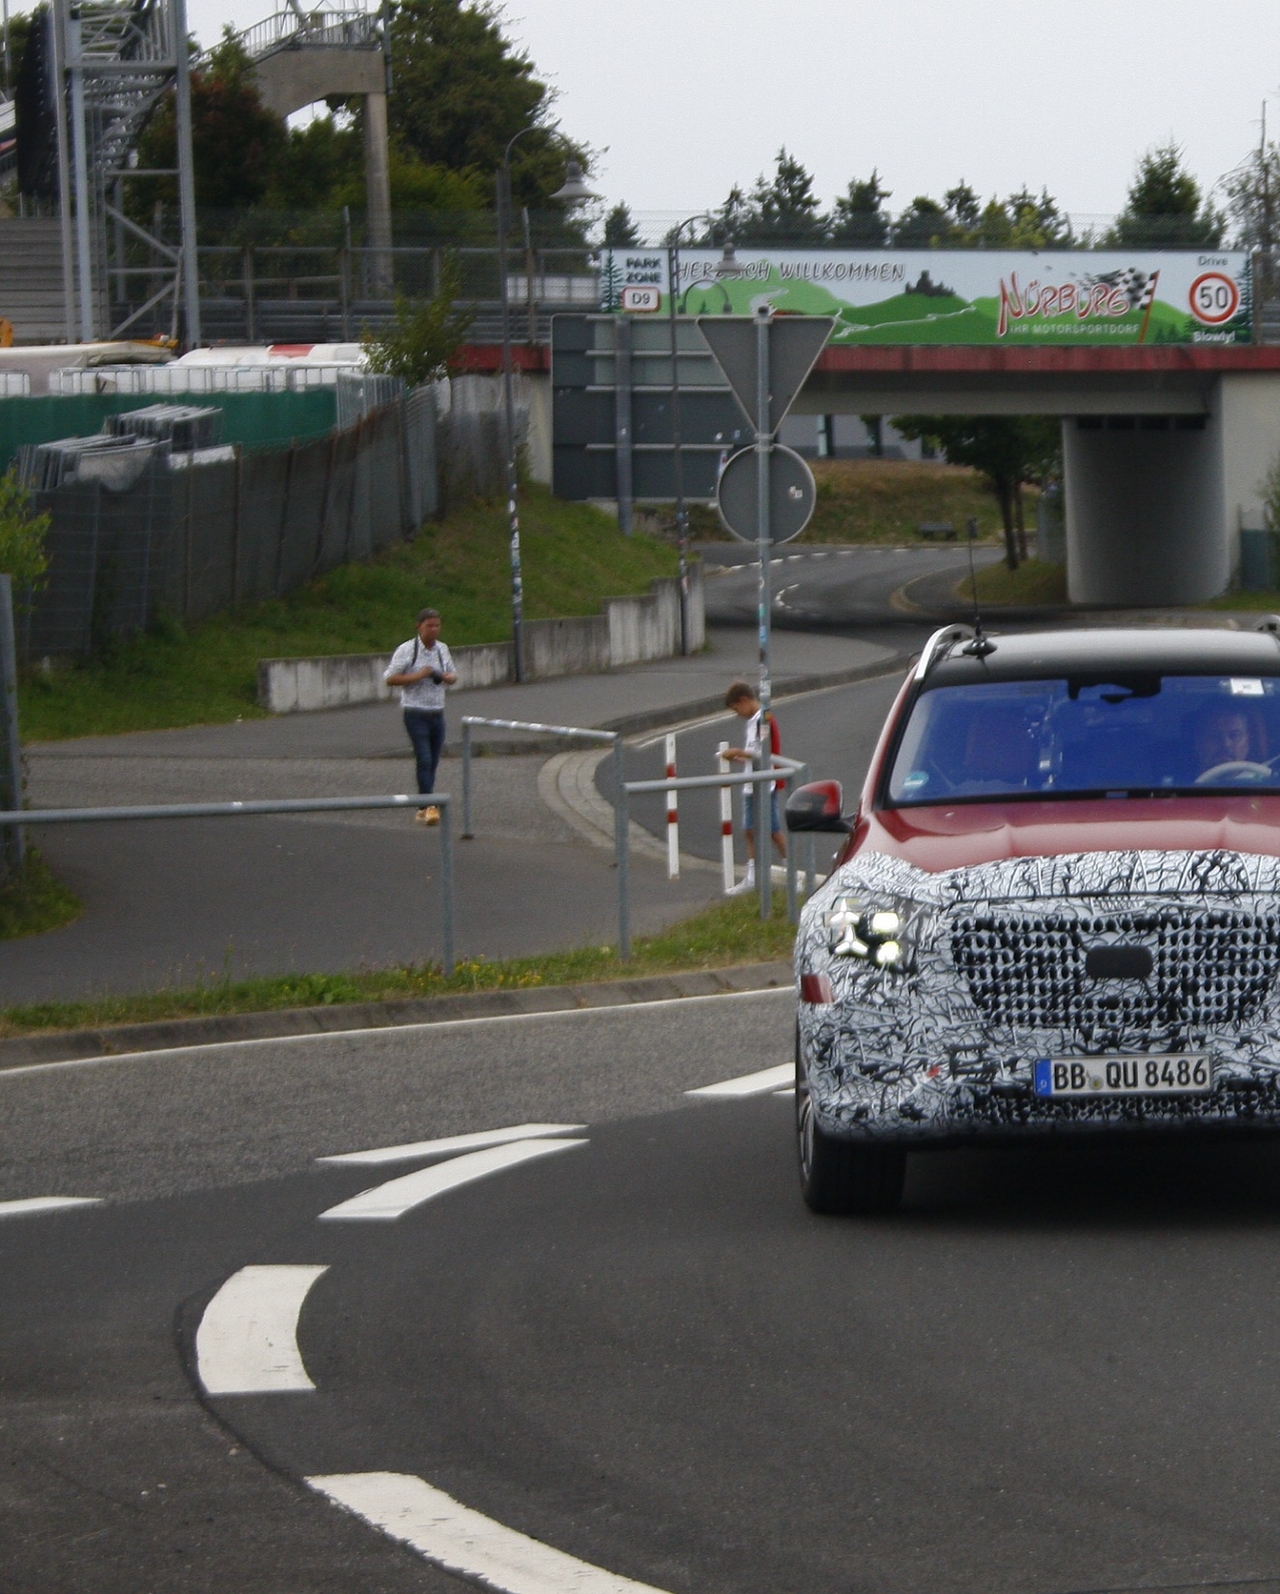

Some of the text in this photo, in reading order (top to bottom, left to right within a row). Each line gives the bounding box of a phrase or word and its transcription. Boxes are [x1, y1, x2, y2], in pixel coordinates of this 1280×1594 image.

[626, 257, 661, 268] PARK
[1198, 256, 1228, 266] Drive
[626, 272, 661, 283] ZONE
[781, 261, 905, 281] WILLKOMMEN
[632, 292, 651, 305] D9
[997, 270, 1131, 337] NÜRBURG
[1200, 286, 1228, 309] 50
[1010, 324, 1139, 333] IHR MOTORSPORTDORF
[1054, 1058, 1208, 1090] BB QU 8486
